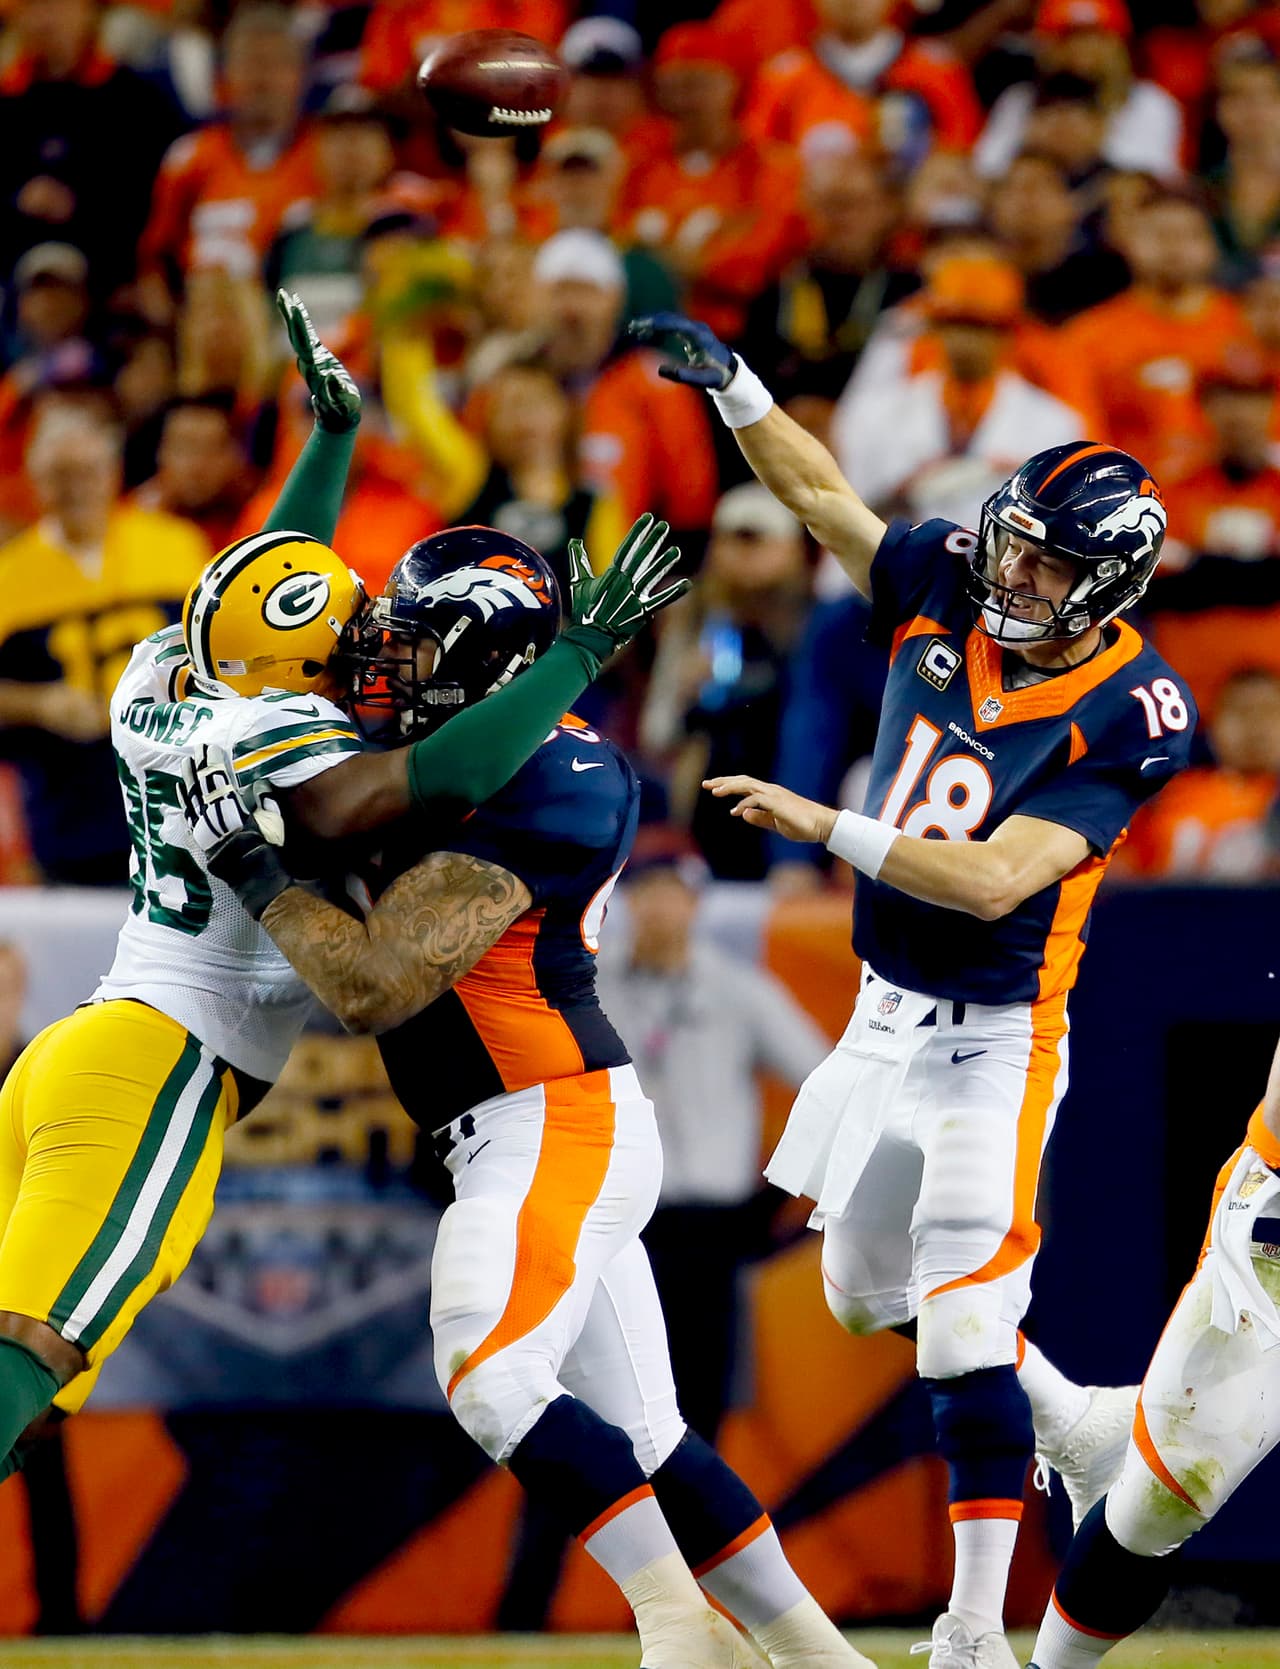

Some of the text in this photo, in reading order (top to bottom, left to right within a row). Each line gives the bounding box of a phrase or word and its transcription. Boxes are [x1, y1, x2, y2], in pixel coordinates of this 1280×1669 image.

[263, 572, 330, 629] G
[925, 644, 957, 680] C
[119, 696, 214, 747] JONES
[1129, 677, 1189, 739] 18
[948, 721, 996, 761] BRONCOS
[879, 713, 994, 842] 18
